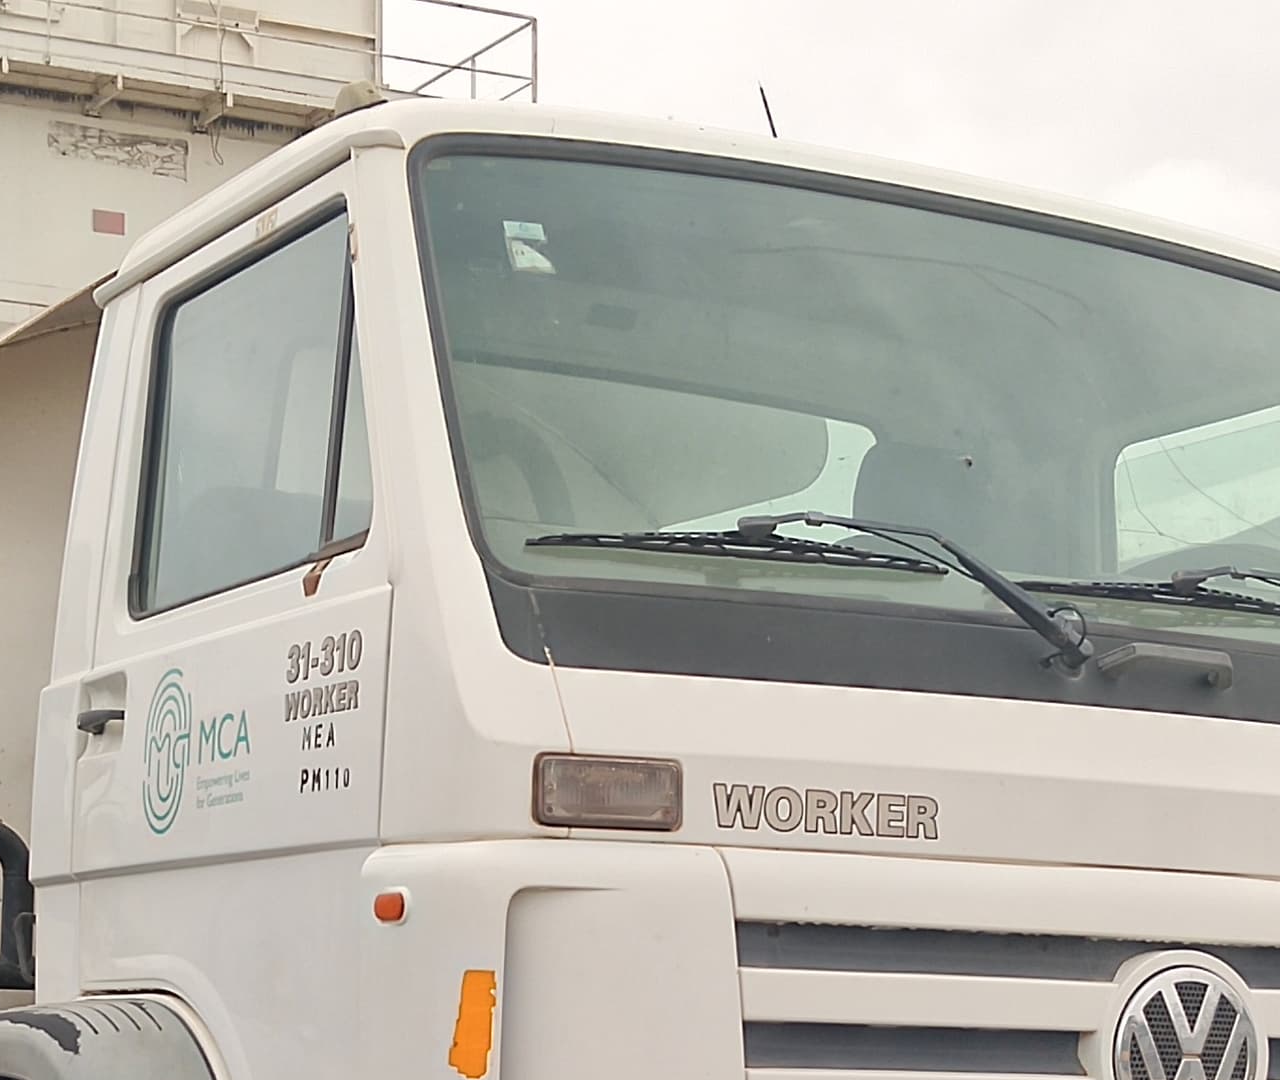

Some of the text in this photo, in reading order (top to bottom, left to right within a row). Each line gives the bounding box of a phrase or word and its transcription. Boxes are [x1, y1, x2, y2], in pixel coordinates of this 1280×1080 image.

[286, 629, 363, 684] 31-310
[284, 679, 359, 722] WORKER
[198, 709, 251, 765] MCA
[302, 722, 335, 751] MEA
[300, 767, 350, 794] PM110
[713, 782, 939, 840] WORKER
